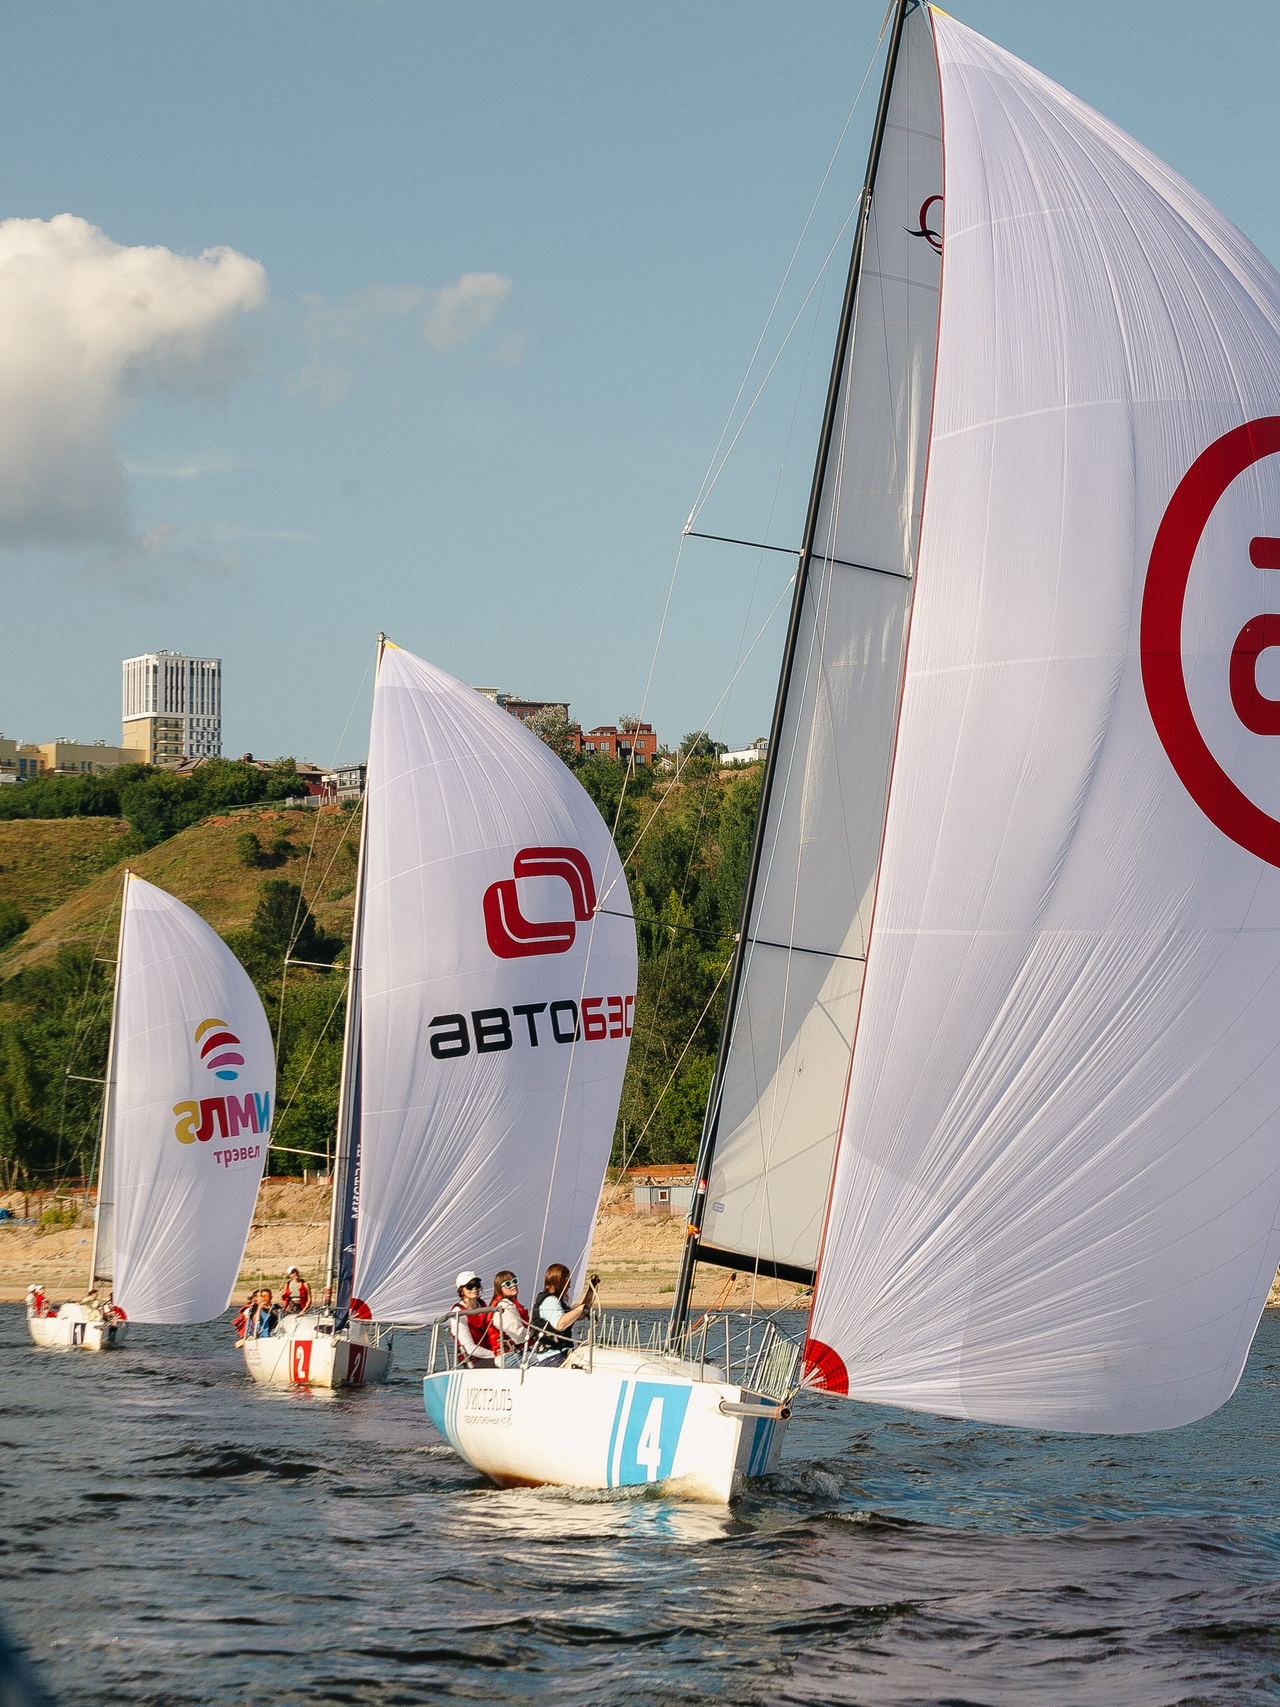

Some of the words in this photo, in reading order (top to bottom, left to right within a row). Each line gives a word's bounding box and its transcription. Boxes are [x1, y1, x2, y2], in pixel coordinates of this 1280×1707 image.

[213, 1145, 260, 1168] трэвел
[74, 1323, 82, 1345] 1
[296, 1345, 306, 1378] 2
[636, 1396, 662, 1482] 4
